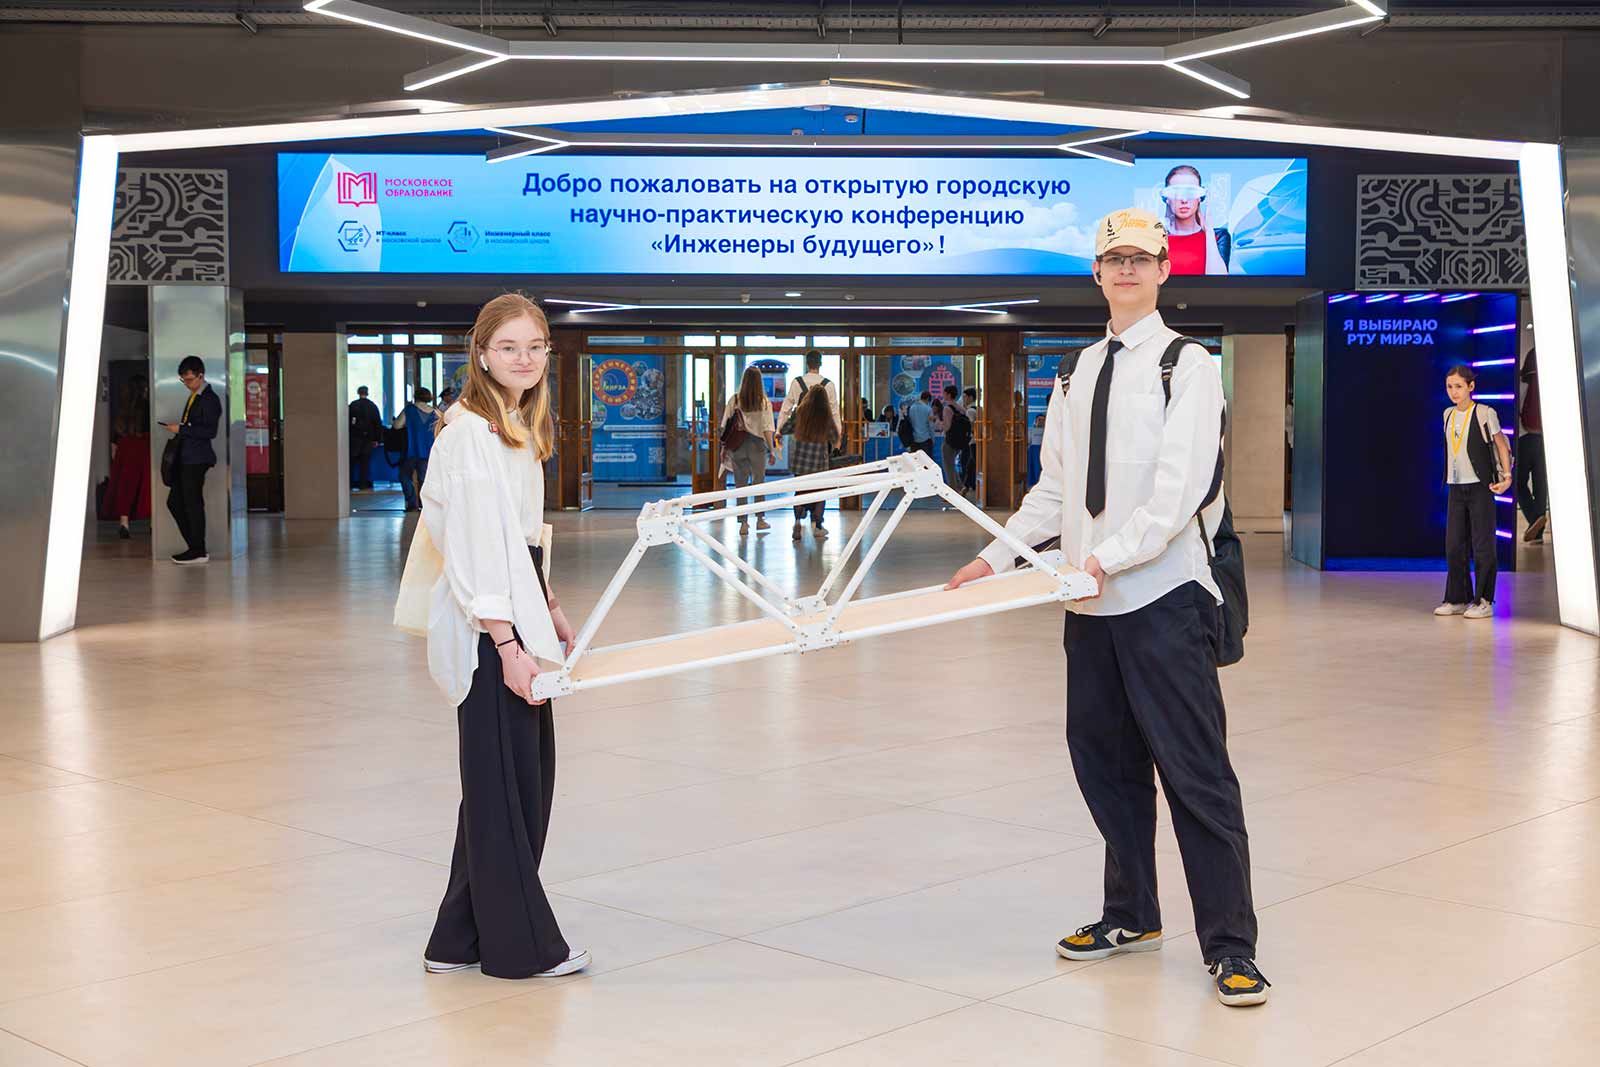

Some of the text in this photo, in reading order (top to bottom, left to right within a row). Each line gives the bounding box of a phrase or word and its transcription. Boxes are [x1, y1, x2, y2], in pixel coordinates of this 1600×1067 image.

[384, 178, 454, 188] МОСКОВСКОЕ
[522, 173, 1071, 200] Добро пожаловать на открытую городскую
[384, 188, 454, 198] ОБРАЗОВАНИЕ
[570, 205, 1024, 229] научно-практическую конференцию
[485, 230, 530, 238] Инженерный
[651, 234, 944, 259] «Инженеры будущего»!
[1343, 319, 1438, 331] Я ВЫБИРАЮ
[1347, 333, 1434, 345] РТУ МИРЭА
